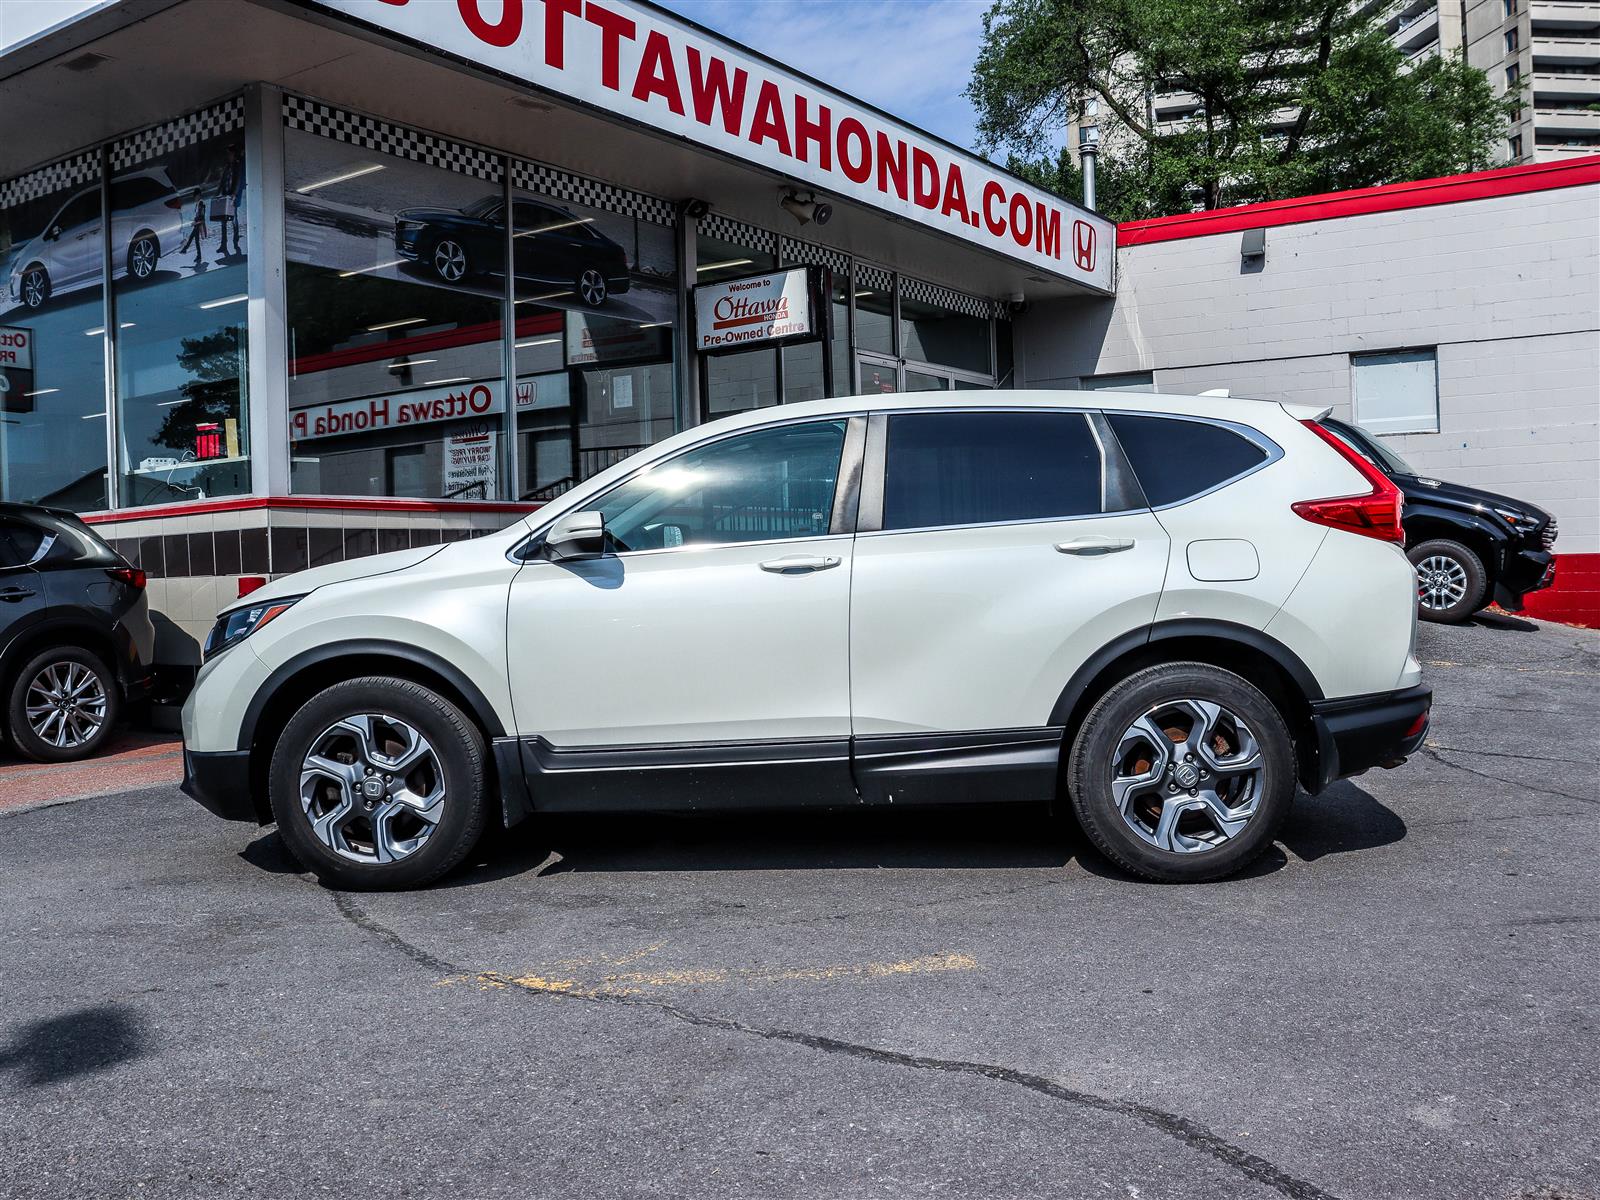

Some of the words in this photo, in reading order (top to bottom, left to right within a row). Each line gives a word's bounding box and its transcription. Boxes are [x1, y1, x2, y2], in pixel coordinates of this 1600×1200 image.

[728, 281, 762, 293] Welcome
[763, 279, 771, 287] to
[713, 296, 789, 321] Ottawa
[763, 311, 787, 321] HONDA
[703, 327, 764, 346] Pre-Owned
[766, 321, 805, 338] Centre
